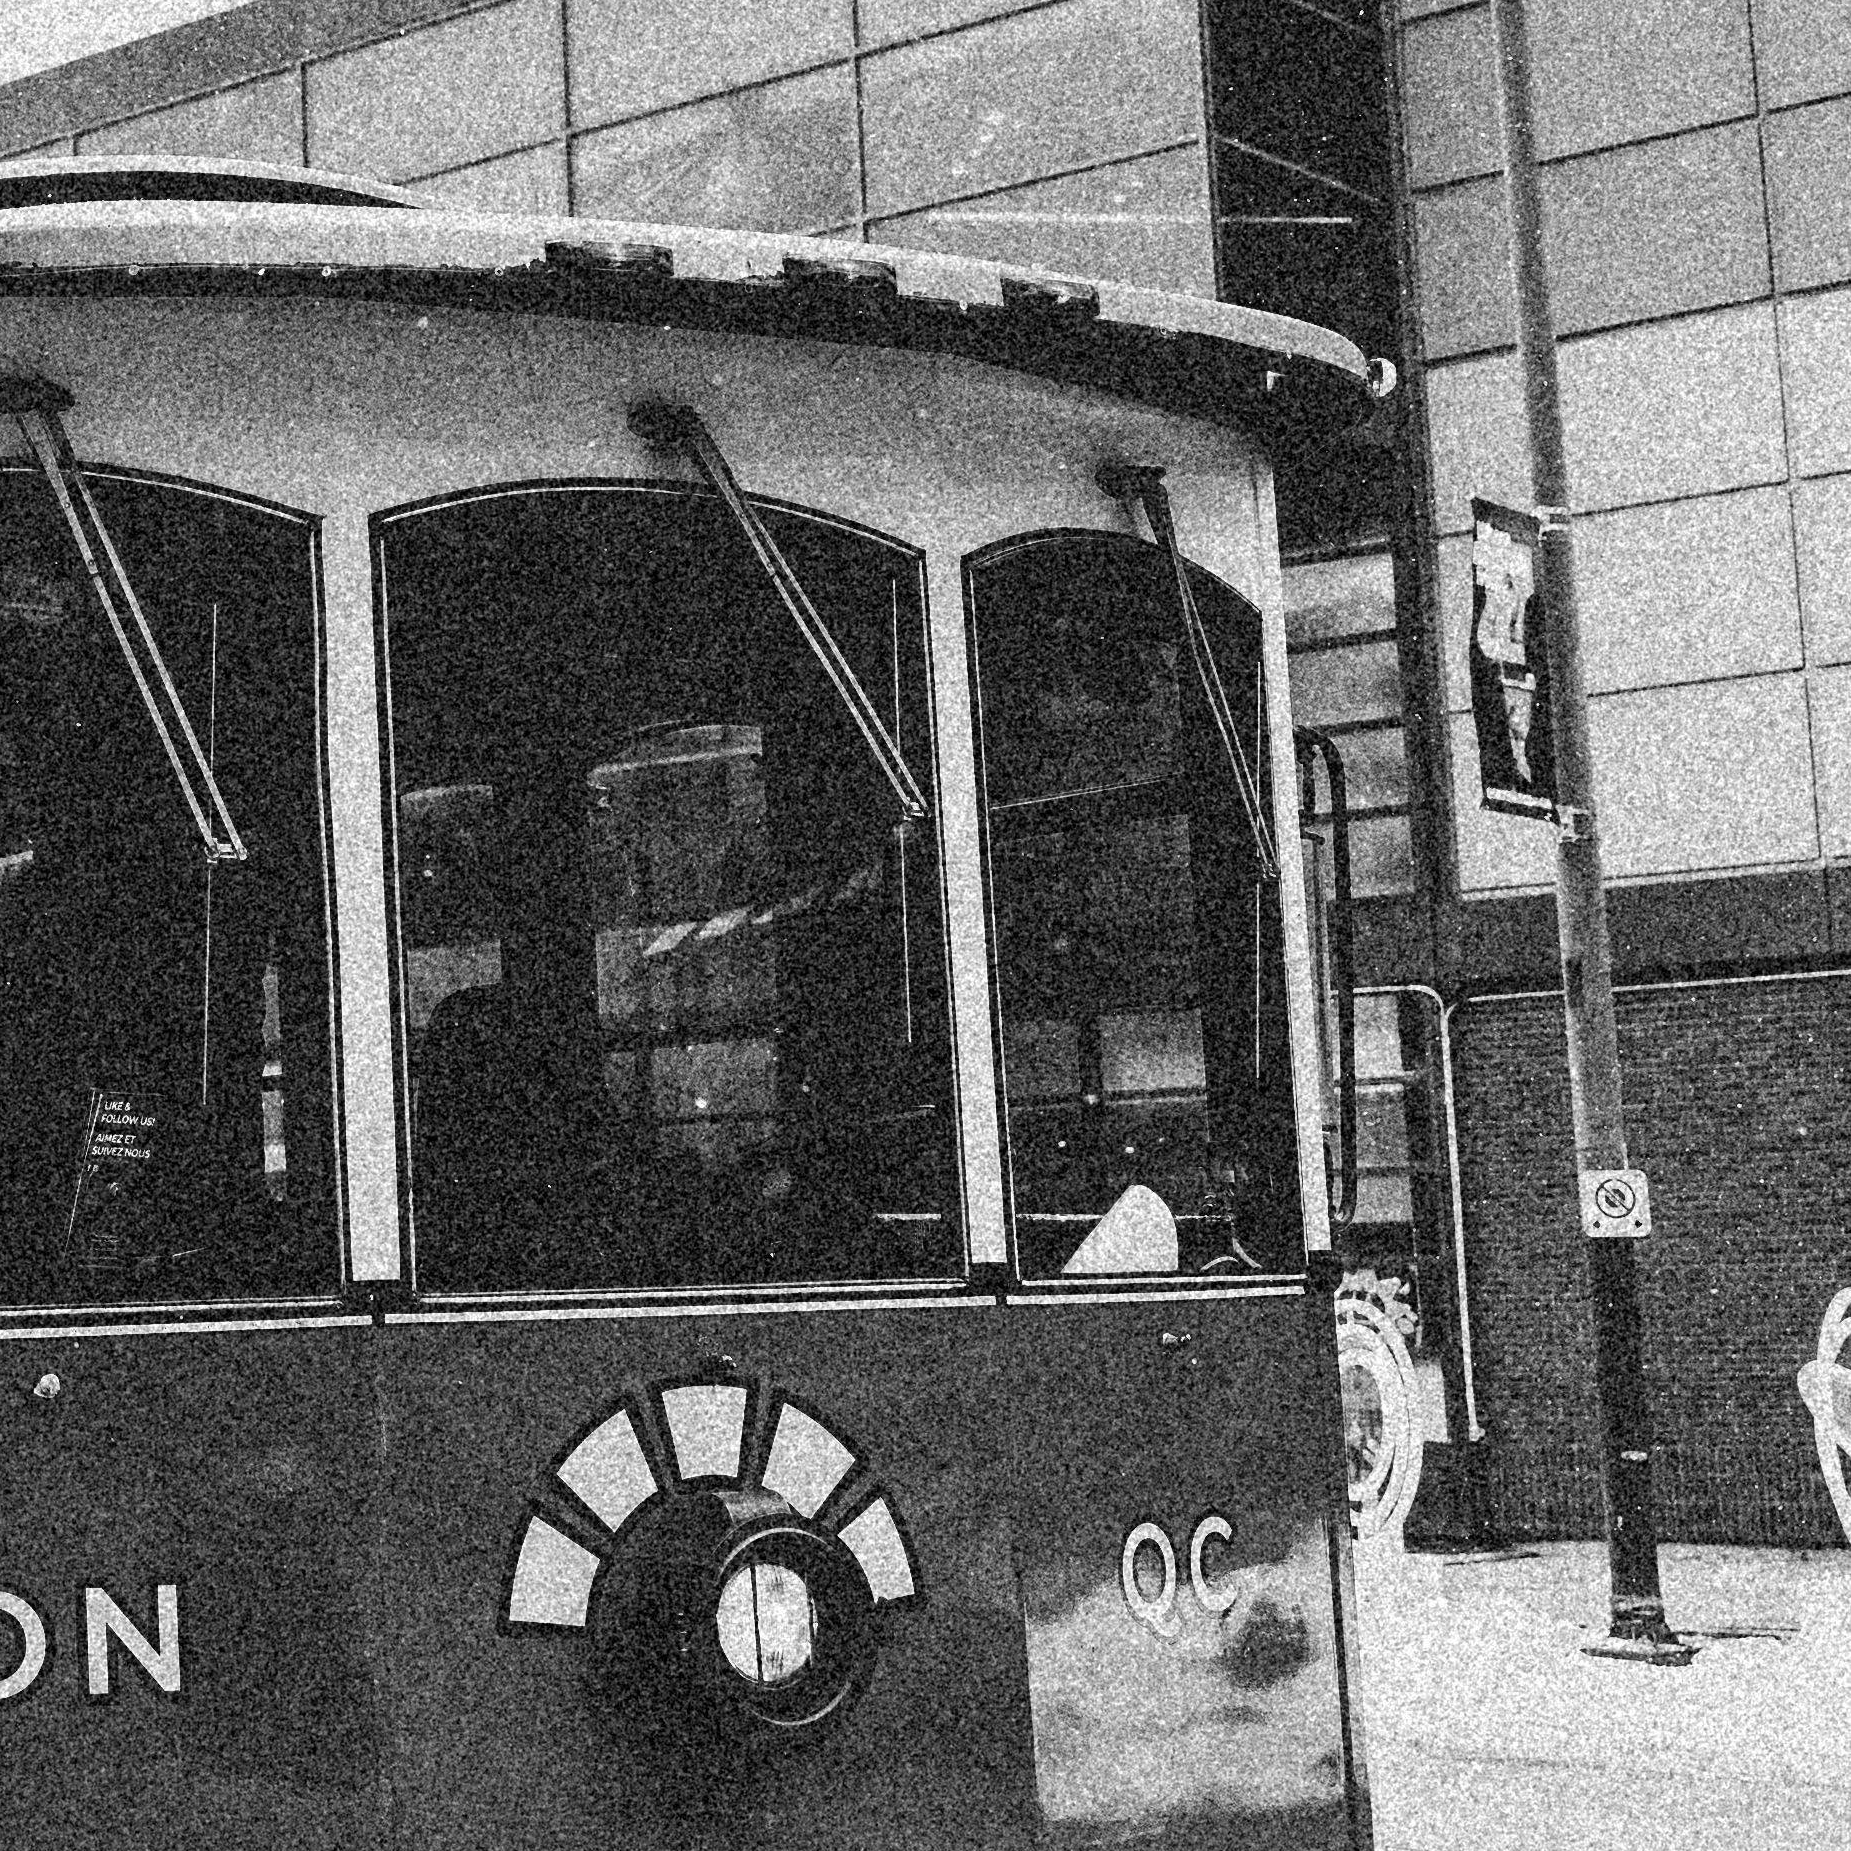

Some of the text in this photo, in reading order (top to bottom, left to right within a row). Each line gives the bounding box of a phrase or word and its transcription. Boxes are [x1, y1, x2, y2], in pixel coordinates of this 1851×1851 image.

[104, 1101, 130, 1111] LIKE &
[101, 1114, 139, 1125] FOLLOW
[95, 1133, 136, 1144] AIMEZ ET
[91, 1146, 150, 1159] SUIVEZ NOUS
